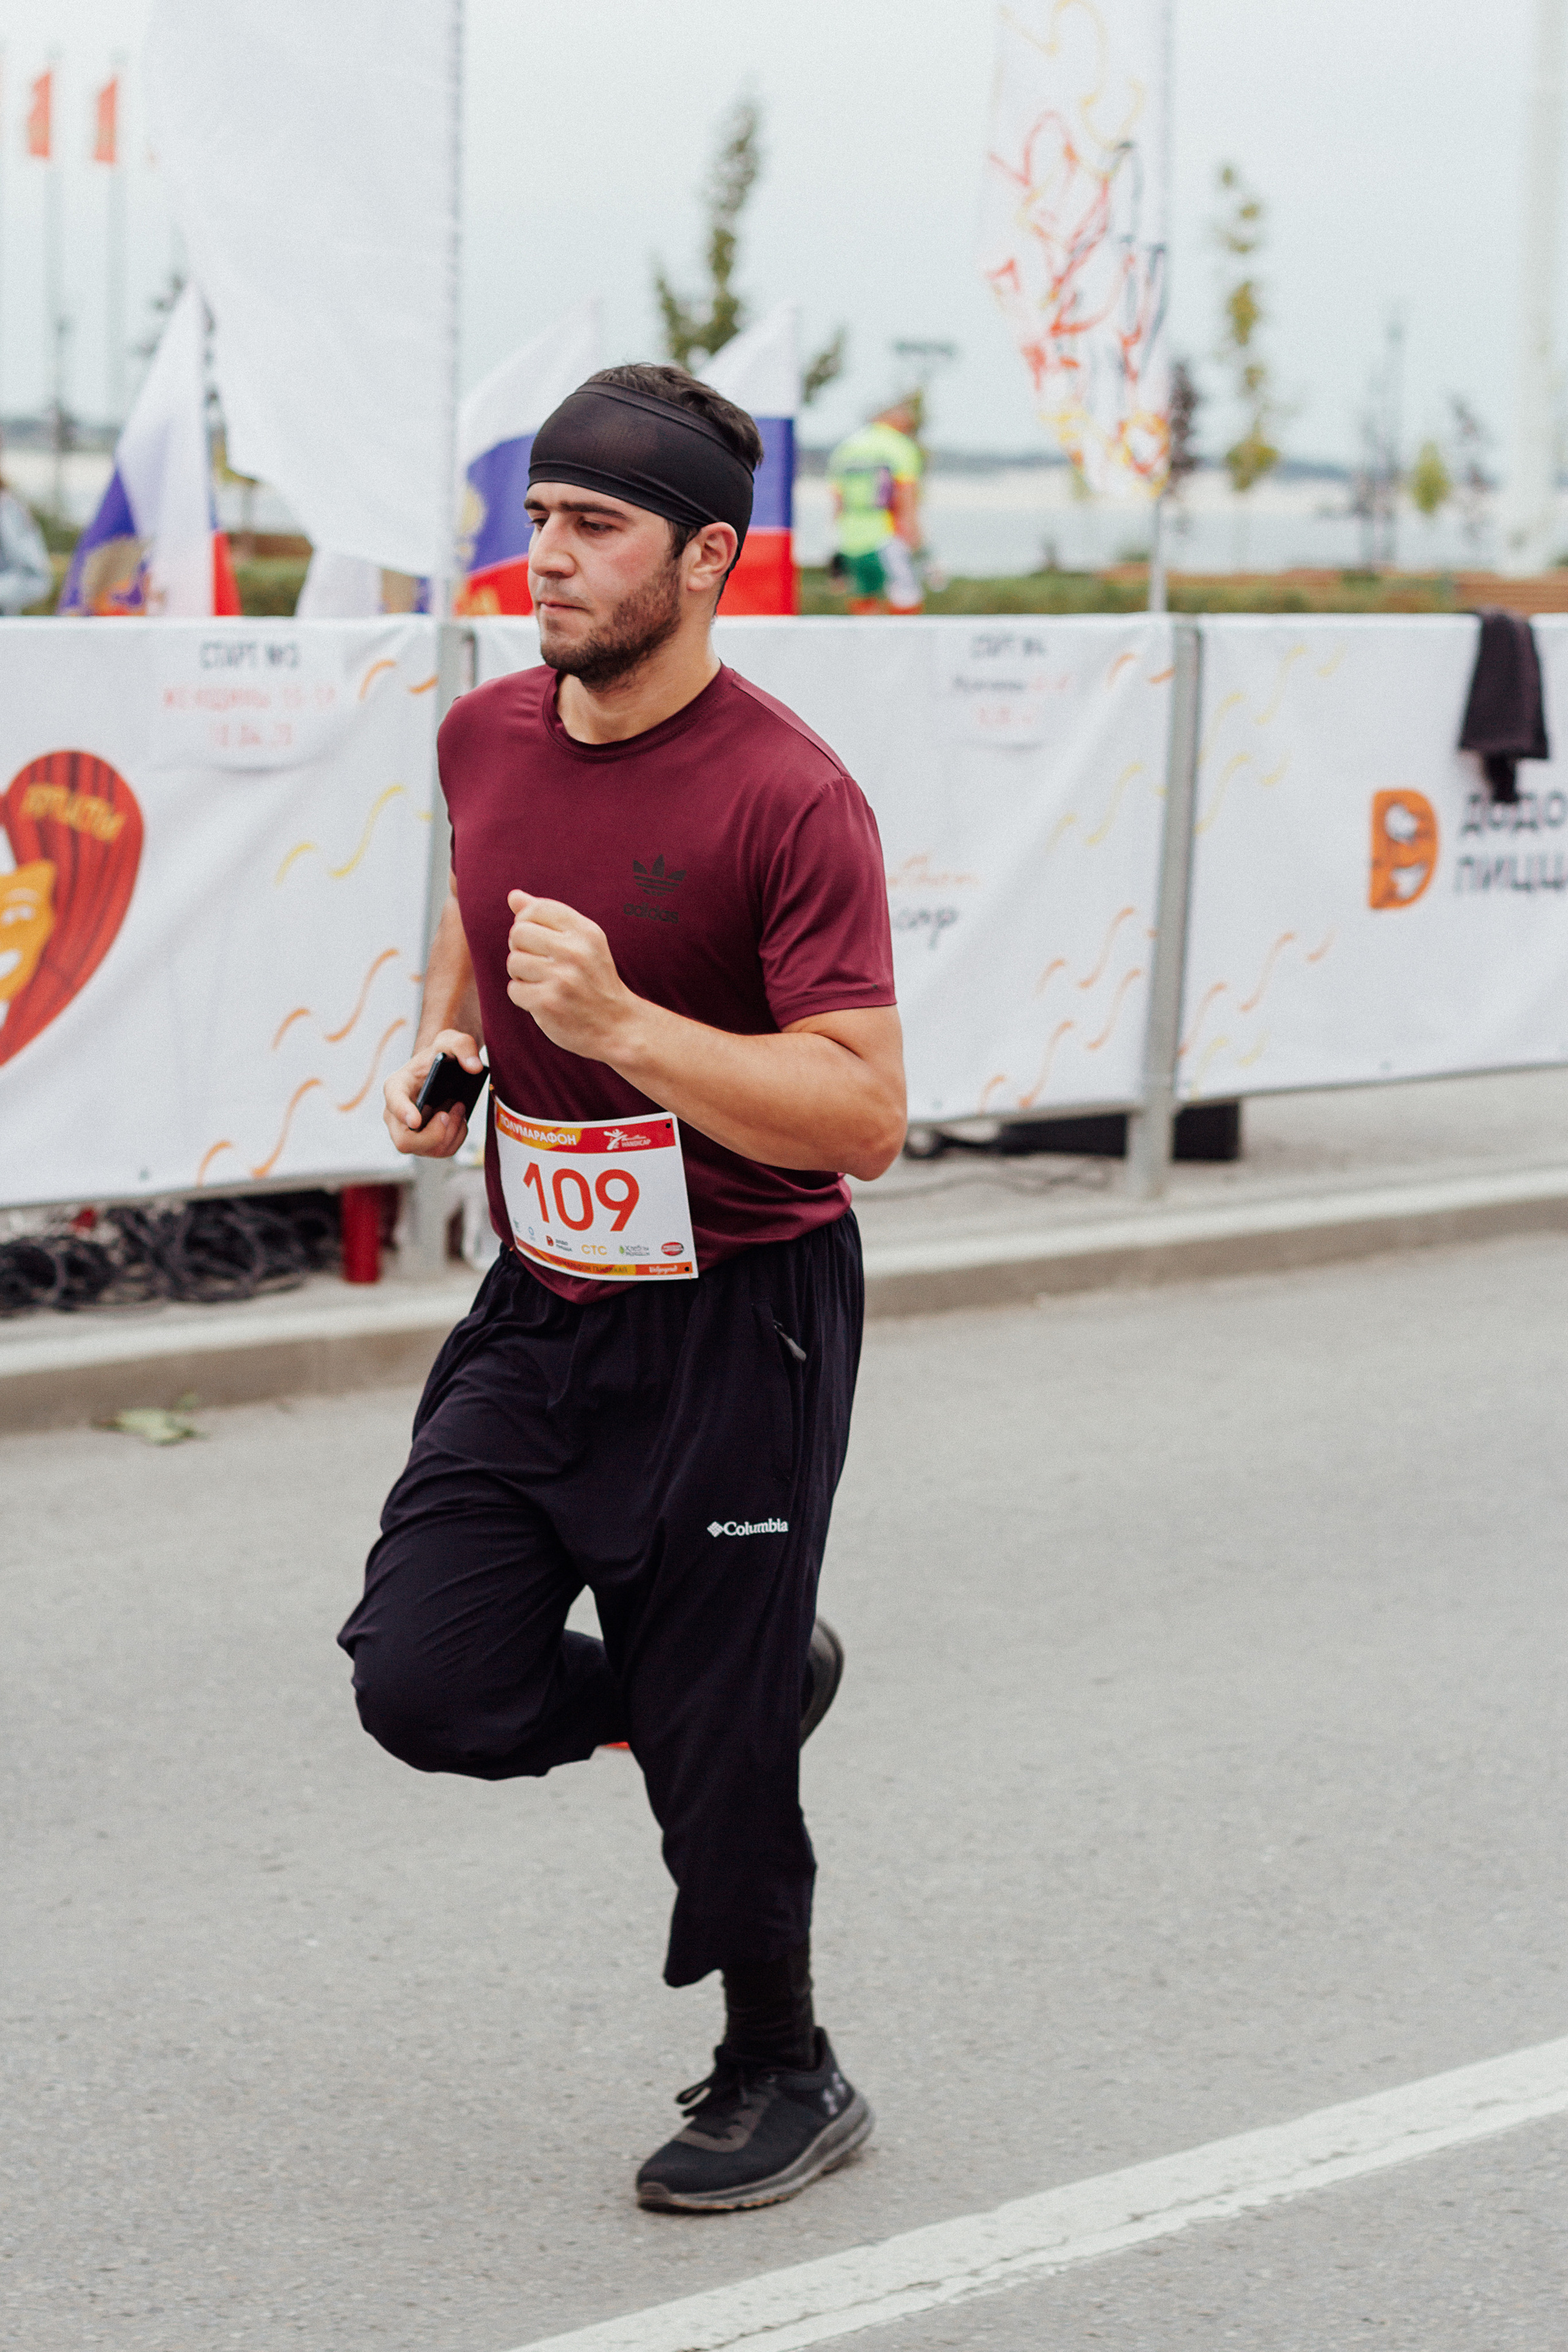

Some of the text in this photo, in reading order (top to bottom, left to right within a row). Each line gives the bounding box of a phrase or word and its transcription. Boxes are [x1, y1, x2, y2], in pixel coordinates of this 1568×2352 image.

[1459, 791, 1567, 837] ДОДО
[1454, 853, 1568, 894] ПИЦЦ
[623, 902, 679, 924] adidas
[500, 1114, 577, 1145] ПОЛУМАРАФОН
[523, 1162, 639, 1232] 109
[723, 1518, 788, 1536] Columbia
